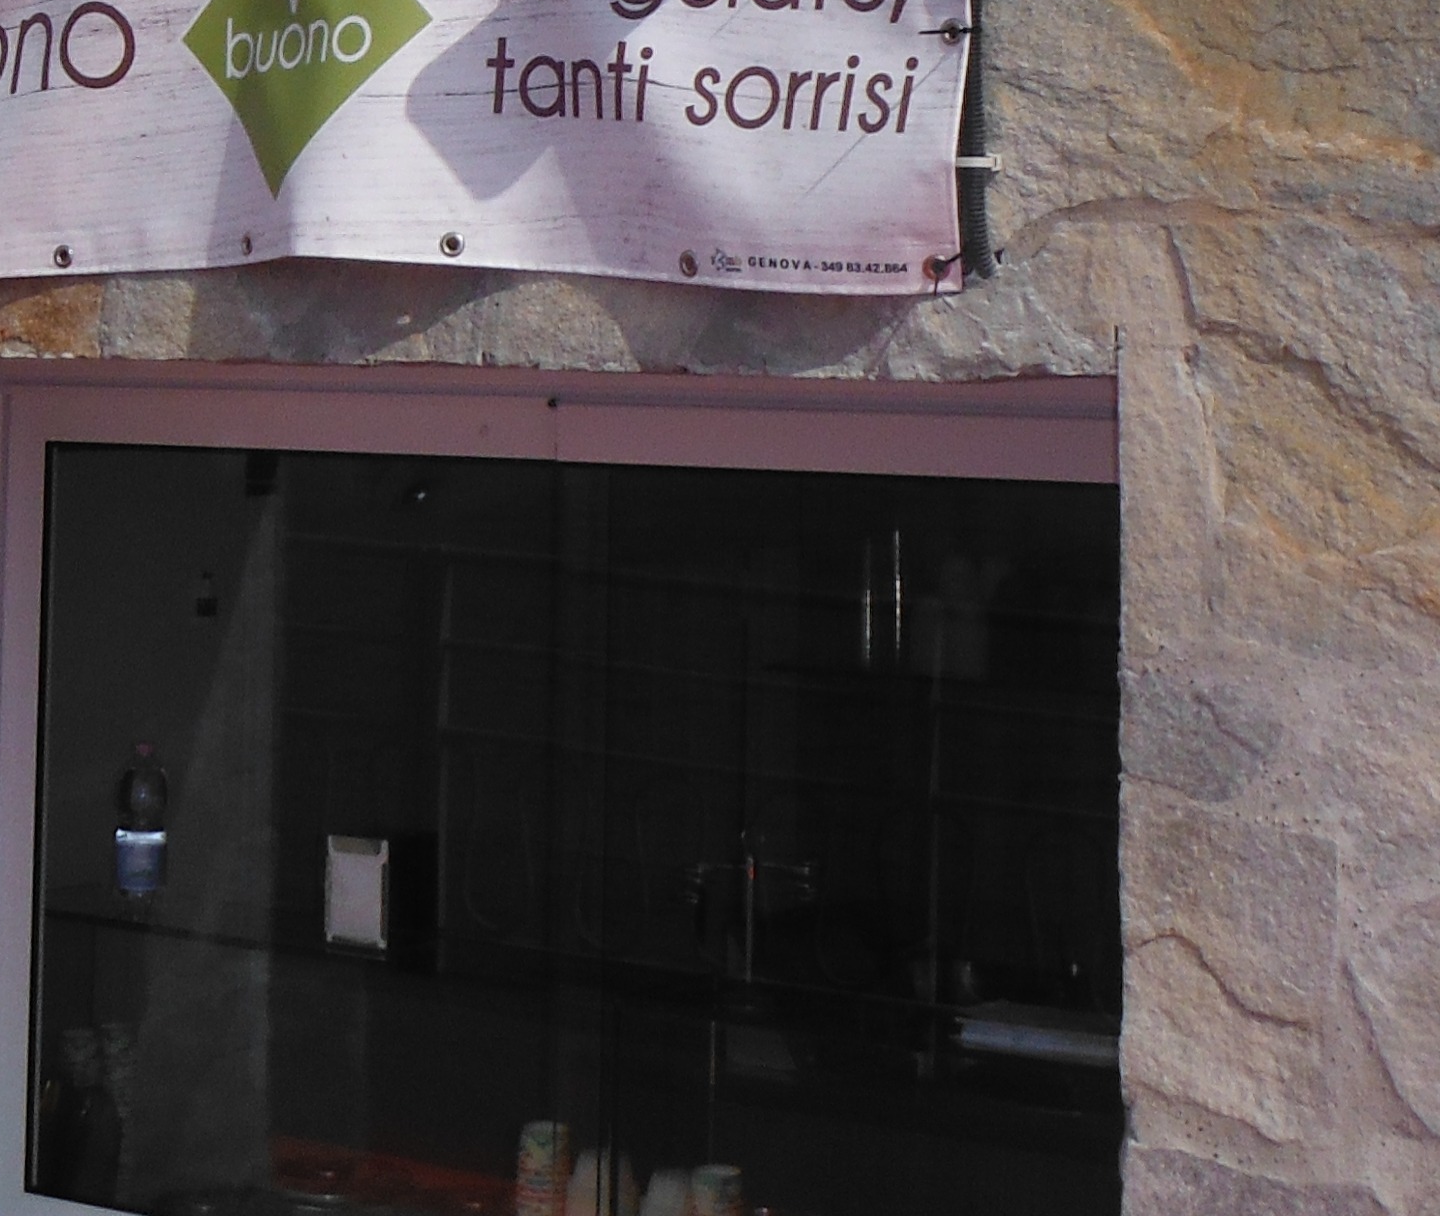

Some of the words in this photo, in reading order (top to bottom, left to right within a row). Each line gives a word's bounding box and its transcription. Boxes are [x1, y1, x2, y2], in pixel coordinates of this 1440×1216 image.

[225, 15, 373, 79] buono
[486, 36, 653, 122] tanti
[685, 54, 919, 134] sorrisi
